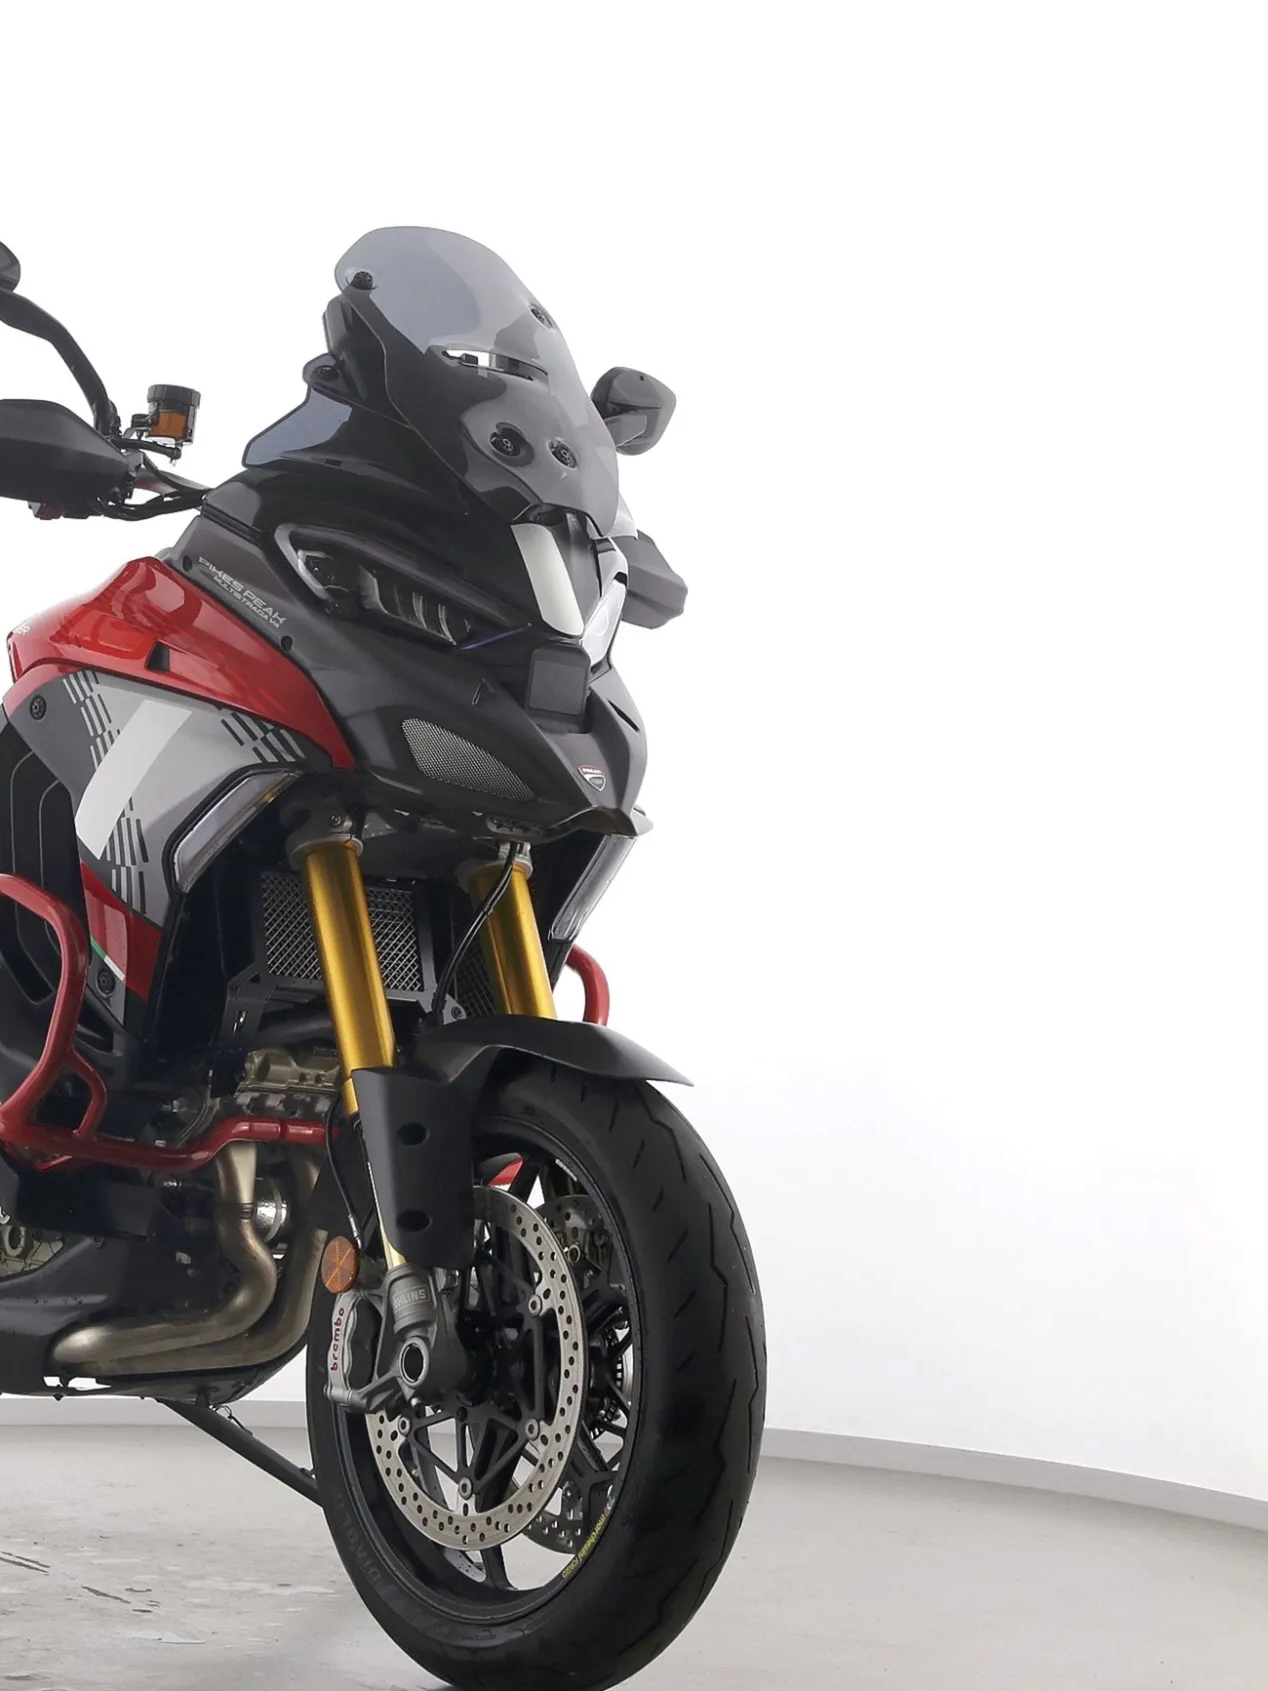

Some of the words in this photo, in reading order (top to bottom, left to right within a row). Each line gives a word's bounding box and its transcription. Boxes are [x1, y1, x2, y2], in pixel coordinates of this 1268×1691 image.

[198, 556, 244, 592] PIKES
[243, 590, 286, 624] PEAK
[213, 575, 268, 620] MULTISTRADA
[330, 1306, 345, 1372] brembo
